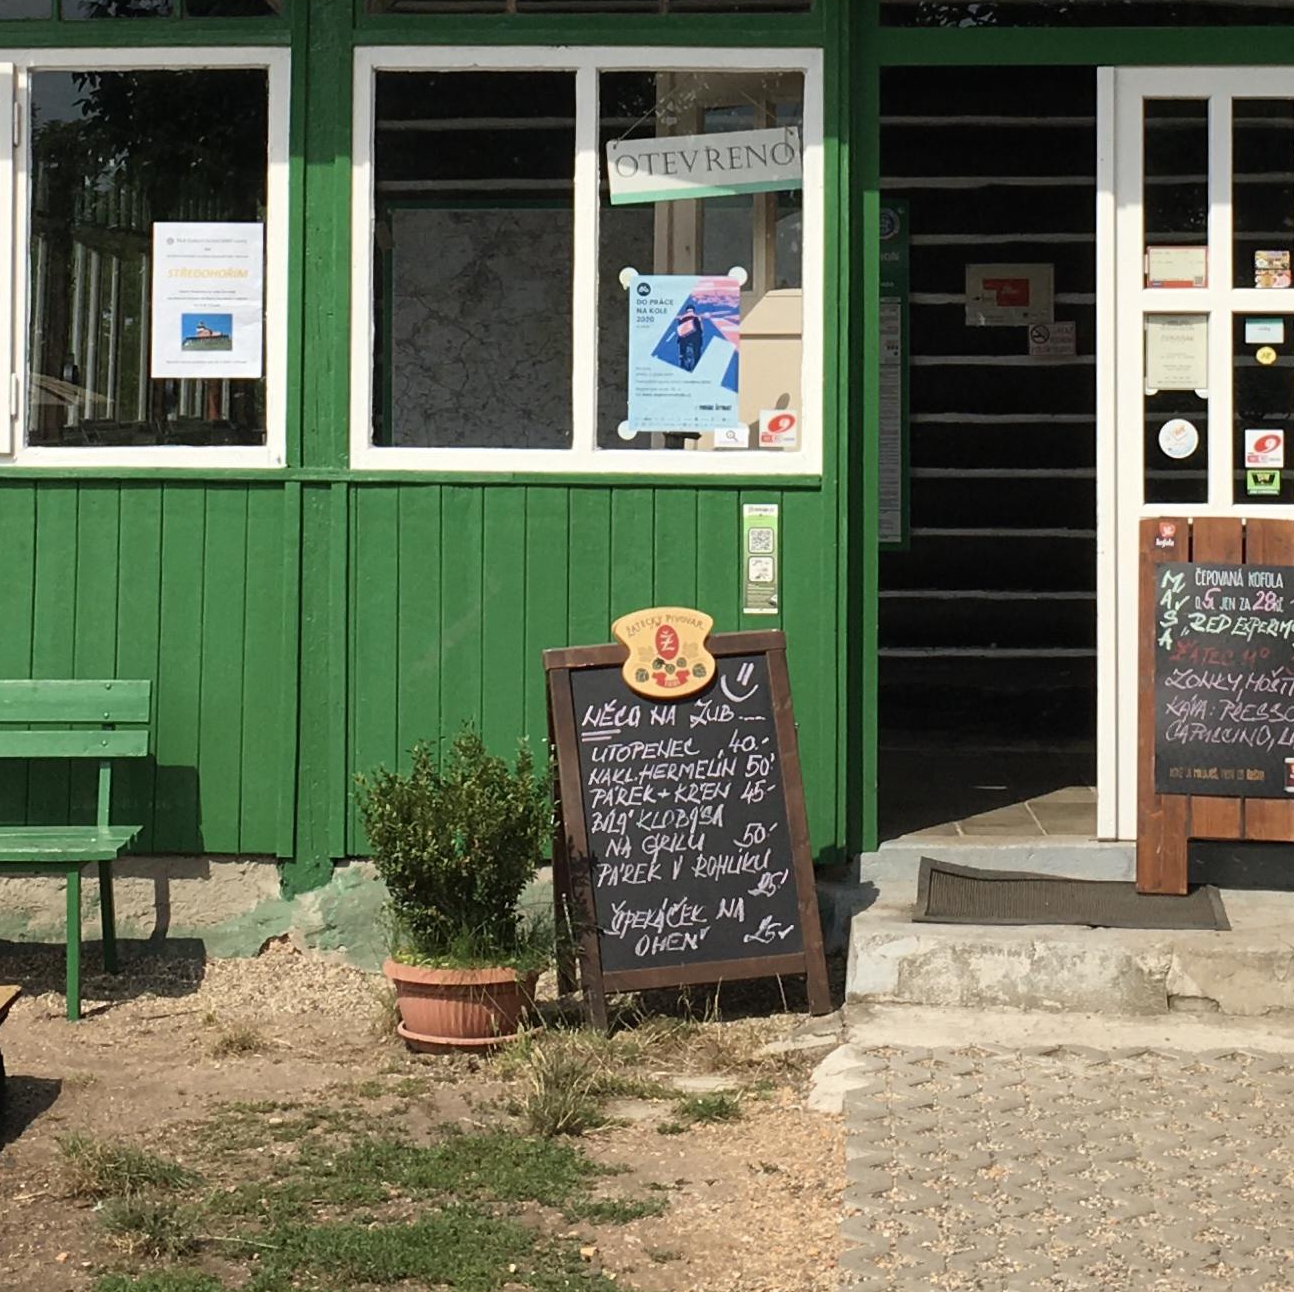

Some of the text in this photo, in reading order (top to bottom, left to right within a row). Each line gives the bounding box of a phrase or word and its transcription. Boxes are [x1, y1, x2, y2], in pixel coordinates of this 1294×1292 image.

[1195, 567, 1283, 588] ČEPOVANÁ KOFOLA
[1219, 597, 1236, 611] JEN
[1239, 597, 1251, 612] ZA
[650, 705, 677, 727] NA
[591, 738, 701, 763] UTOPENEC
[605, 835, 632, 859] NA
[642, 832, 705, 858] GRILU
[672, 855, 683, 881] V
[715, 898, 745, 922] NA
